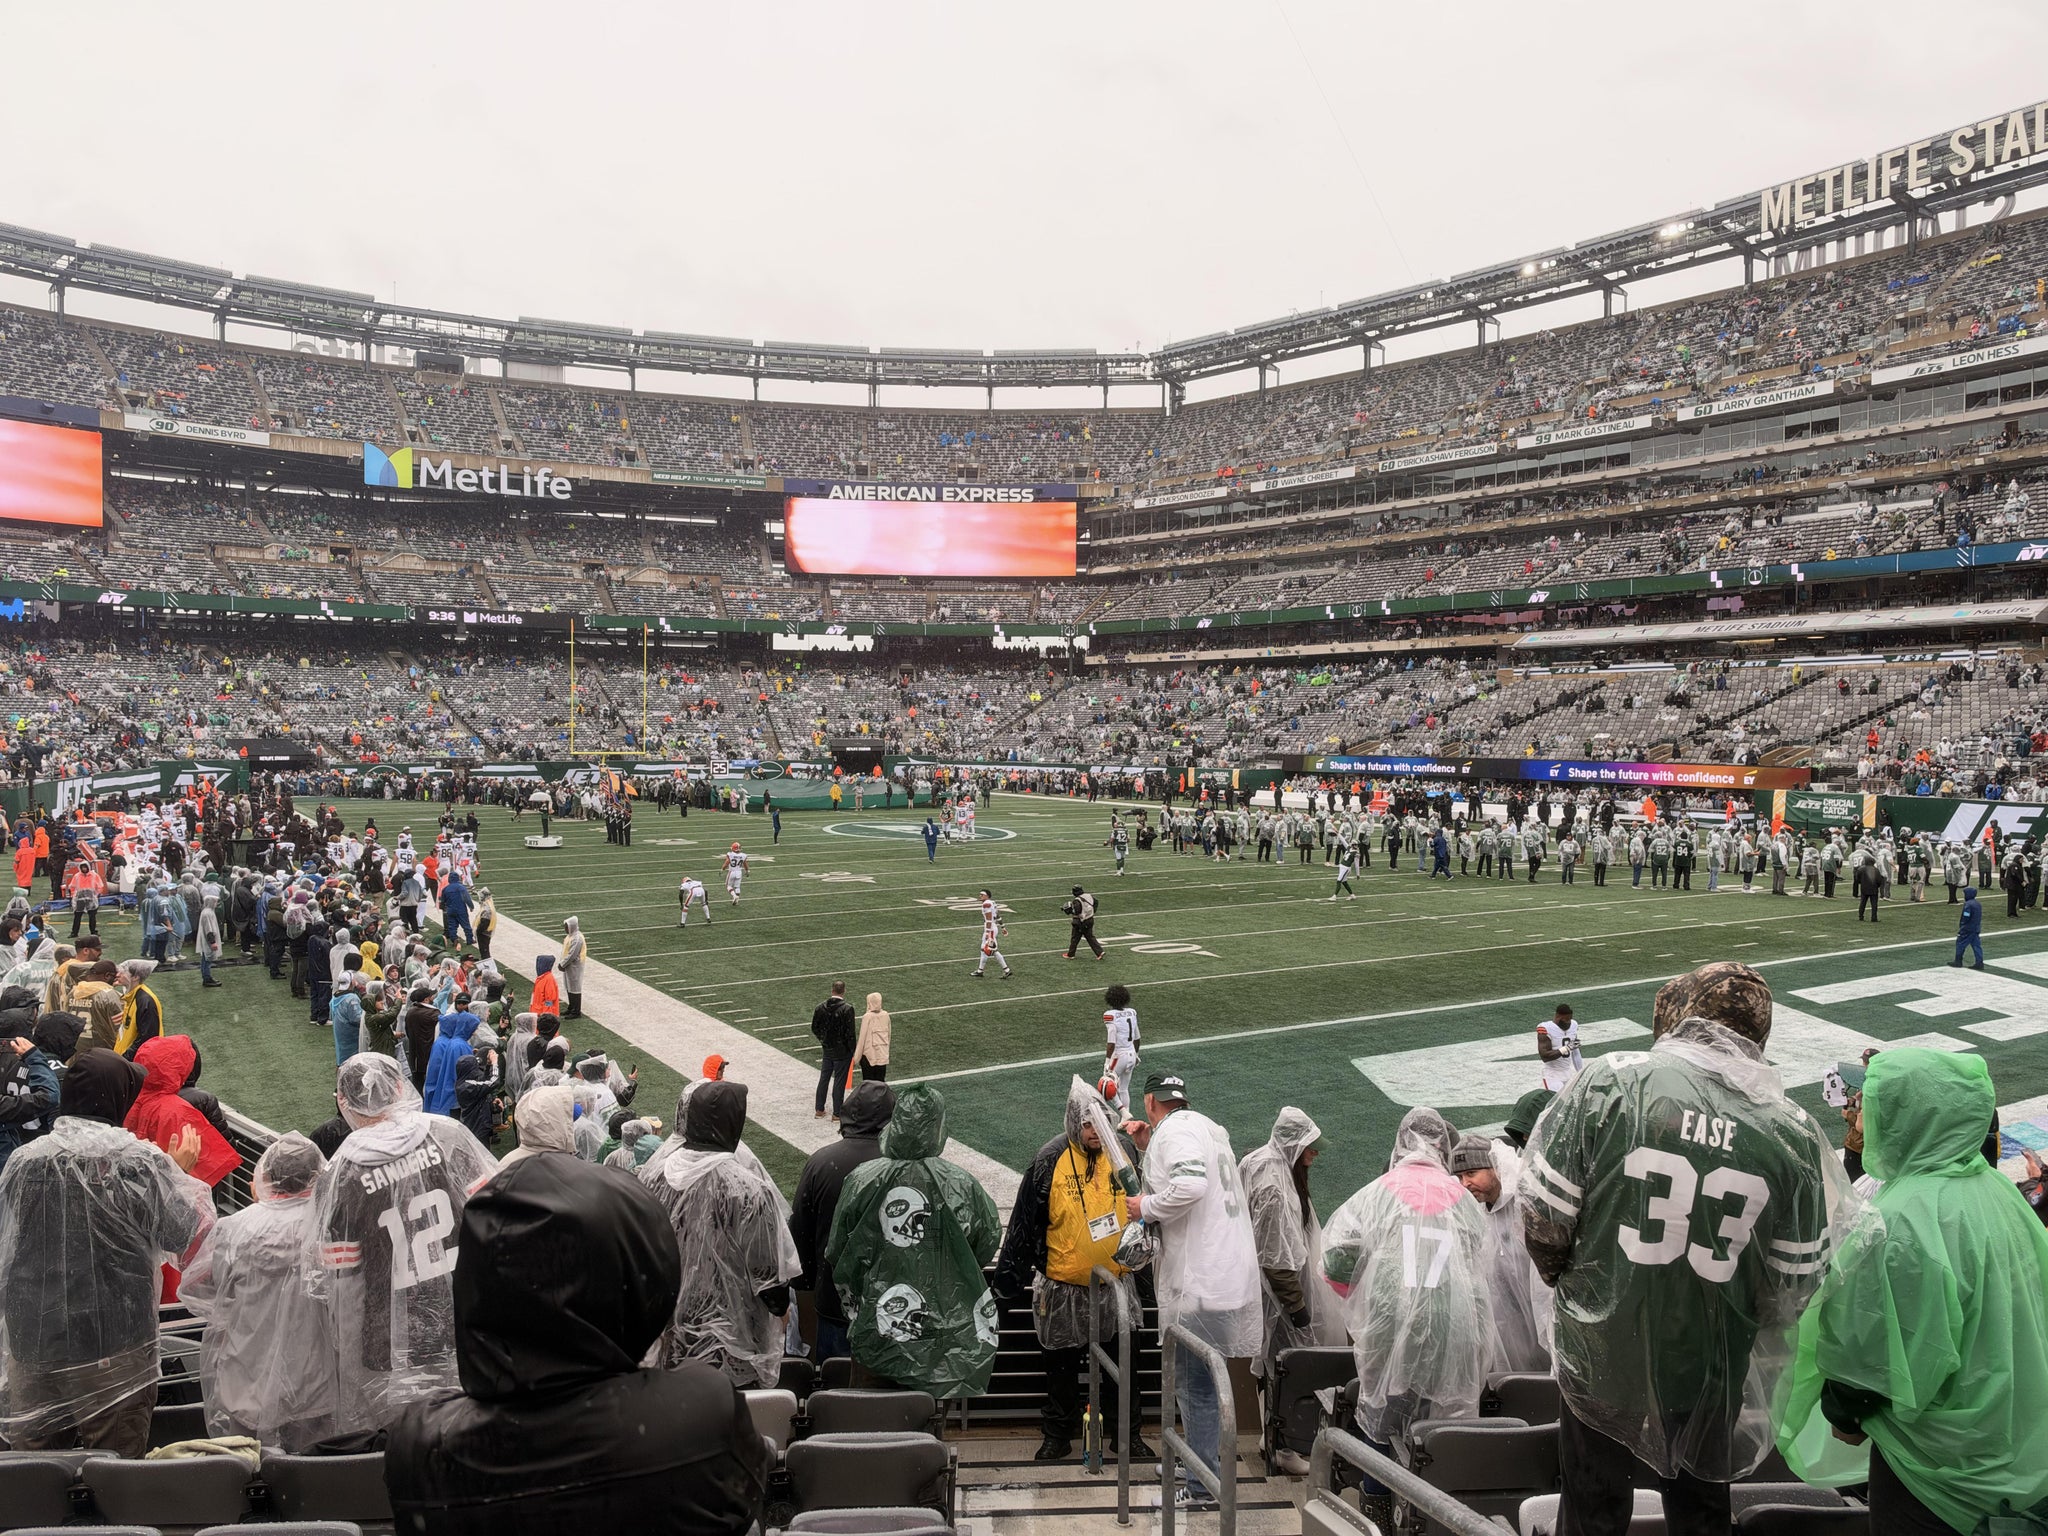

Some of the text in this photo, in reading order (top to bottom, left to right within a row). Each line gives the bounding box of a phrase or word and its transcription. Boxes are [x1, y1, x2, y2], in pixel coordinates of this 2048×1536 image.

[1761, 140, 1932, 232] METLIFE
[1953, 352, 1985, 368] LEON
[1986, 343, 2020, 360] HESS
[1694, 385, 1816, 418] 60 LARRY GRANTHAM
[155, 420, 246, 440] 90 DENNIS BYRD
[1535, 419, 1635, 445] 99 MARK GASTINEAU
[1380, 445, 1495, 471] 60 D'BRICKASHAW FERGUSON
[419, 456, 573, 500] MetLife
[653, 472, 671, 480] NEED
[1265, 470, 1339, 489] 80 WAYNE CHREBET
[828, 485, 1035, 503] AMERICAN EXPRESS
[1145, 490, 1215, 507] 32 EMERSON BOOZER
[1974, 605, 2031, 616] MetLife
[428, 611, 523, 625] 9:36 MetLife
[1694, 616, 1808, 633] METLIFE STADIUM
[713, 763, 727, 774] 25
[1329, 761, 1456, 773] Shape the future with confidence
[1461, 766, 1471, 774] EY
[1549, 769, 1560, 777] EY
[1568, 767, 1735, 784] Shape the future with confidence
[1743, 776, 1756, 785] EY
[1823, 798, 1856, 808] CRUCIAL
[1822, 807, 1848, 816] CATCH
[1117, 832, 1127, 843] 42
[1482, 835, 1493, 846] 76
[1501, 838, 1512, 848] 78
[467, 848, 473, 857] 2
[1656, 845, 1667, 855] 82
[400, 853, 413, 865] 58
[730, 859, 745, 868] 34
[1853, 856, 1864, 867] 97
[69, 998, 93, 1008] SANDERS
[1126, 1017, 1133, 1042] 1
[1160, 1075, 1184, 1087] JETS
[1680, 1109, 1737, 1152] EASE
[360, 1144, 442, 1195] SANDERS
[1617, 1146, 1770, 1283] 33
[377, 1188, 460, 1290] 12
[1402, 1224, 1453, 1288] 17
